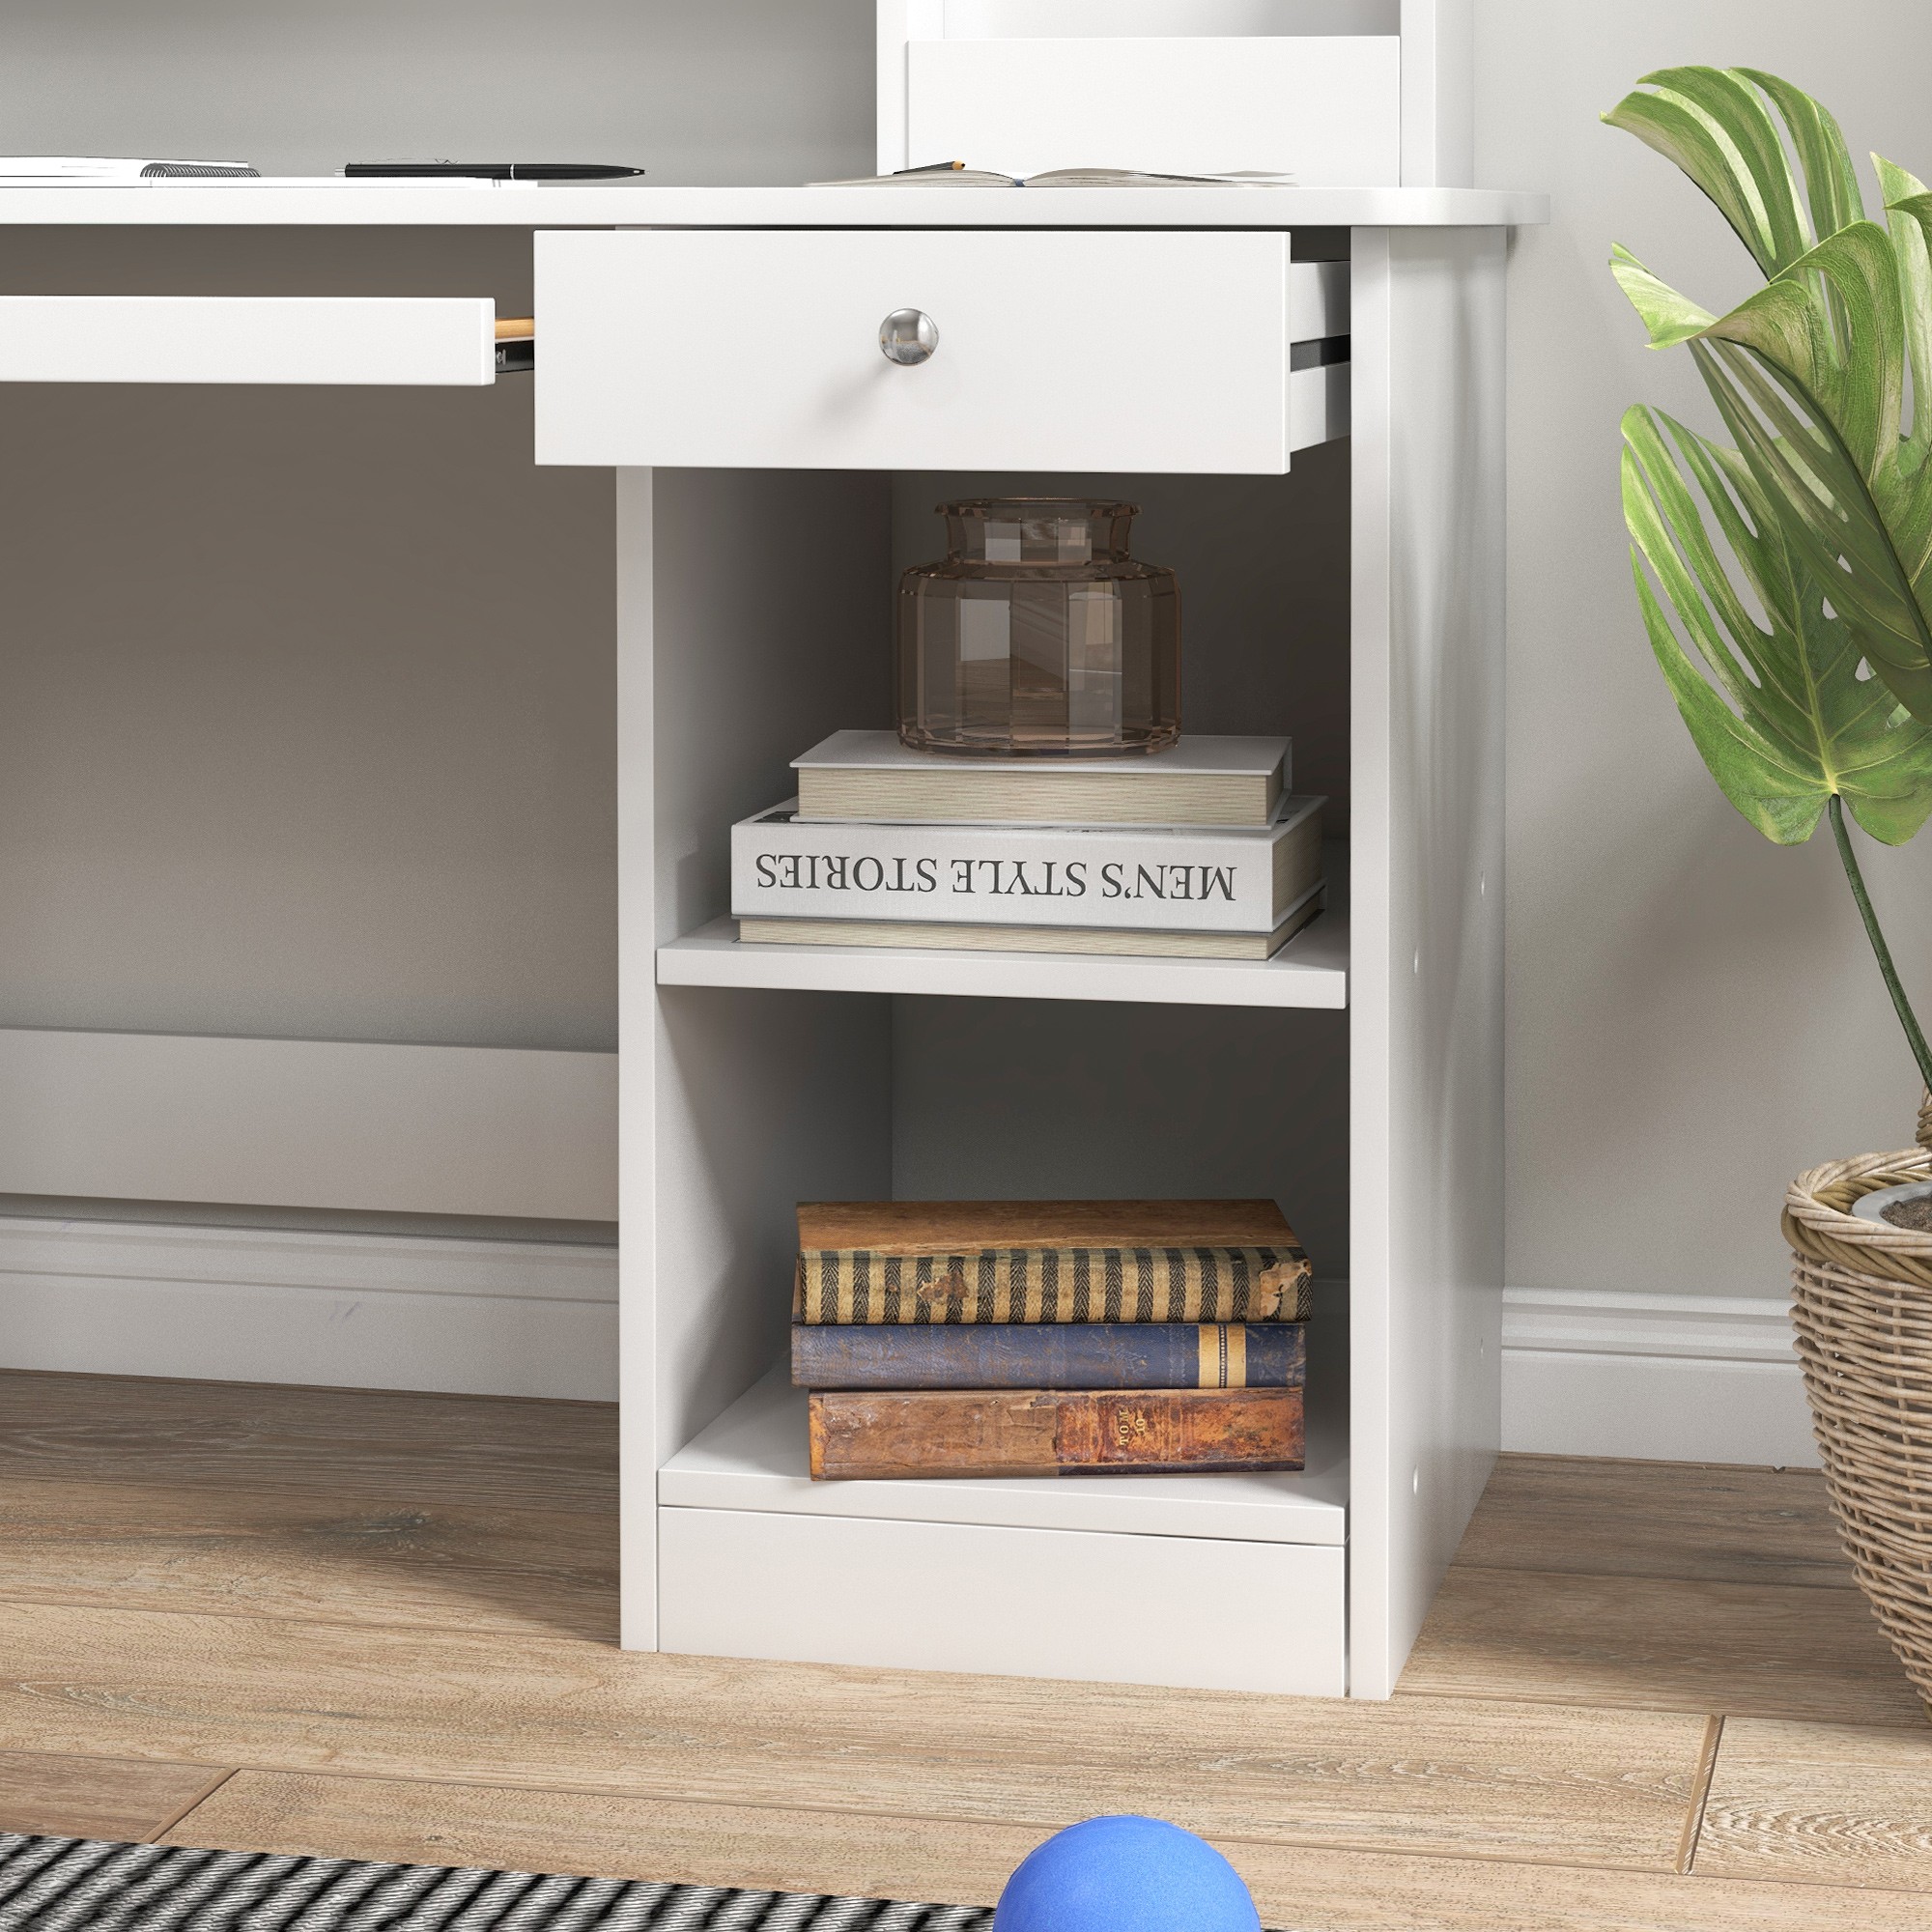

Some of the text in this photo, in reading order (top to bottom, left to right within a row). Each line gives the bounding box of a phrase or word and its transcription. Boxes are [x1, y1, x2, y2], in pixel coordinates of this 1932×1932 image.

[755, 853, 1237, 901] MEN'S STYLE STORIES
[1119, 1409, 1129, 1446] TOM
[1135, 1418, 1146, 1435] 10
